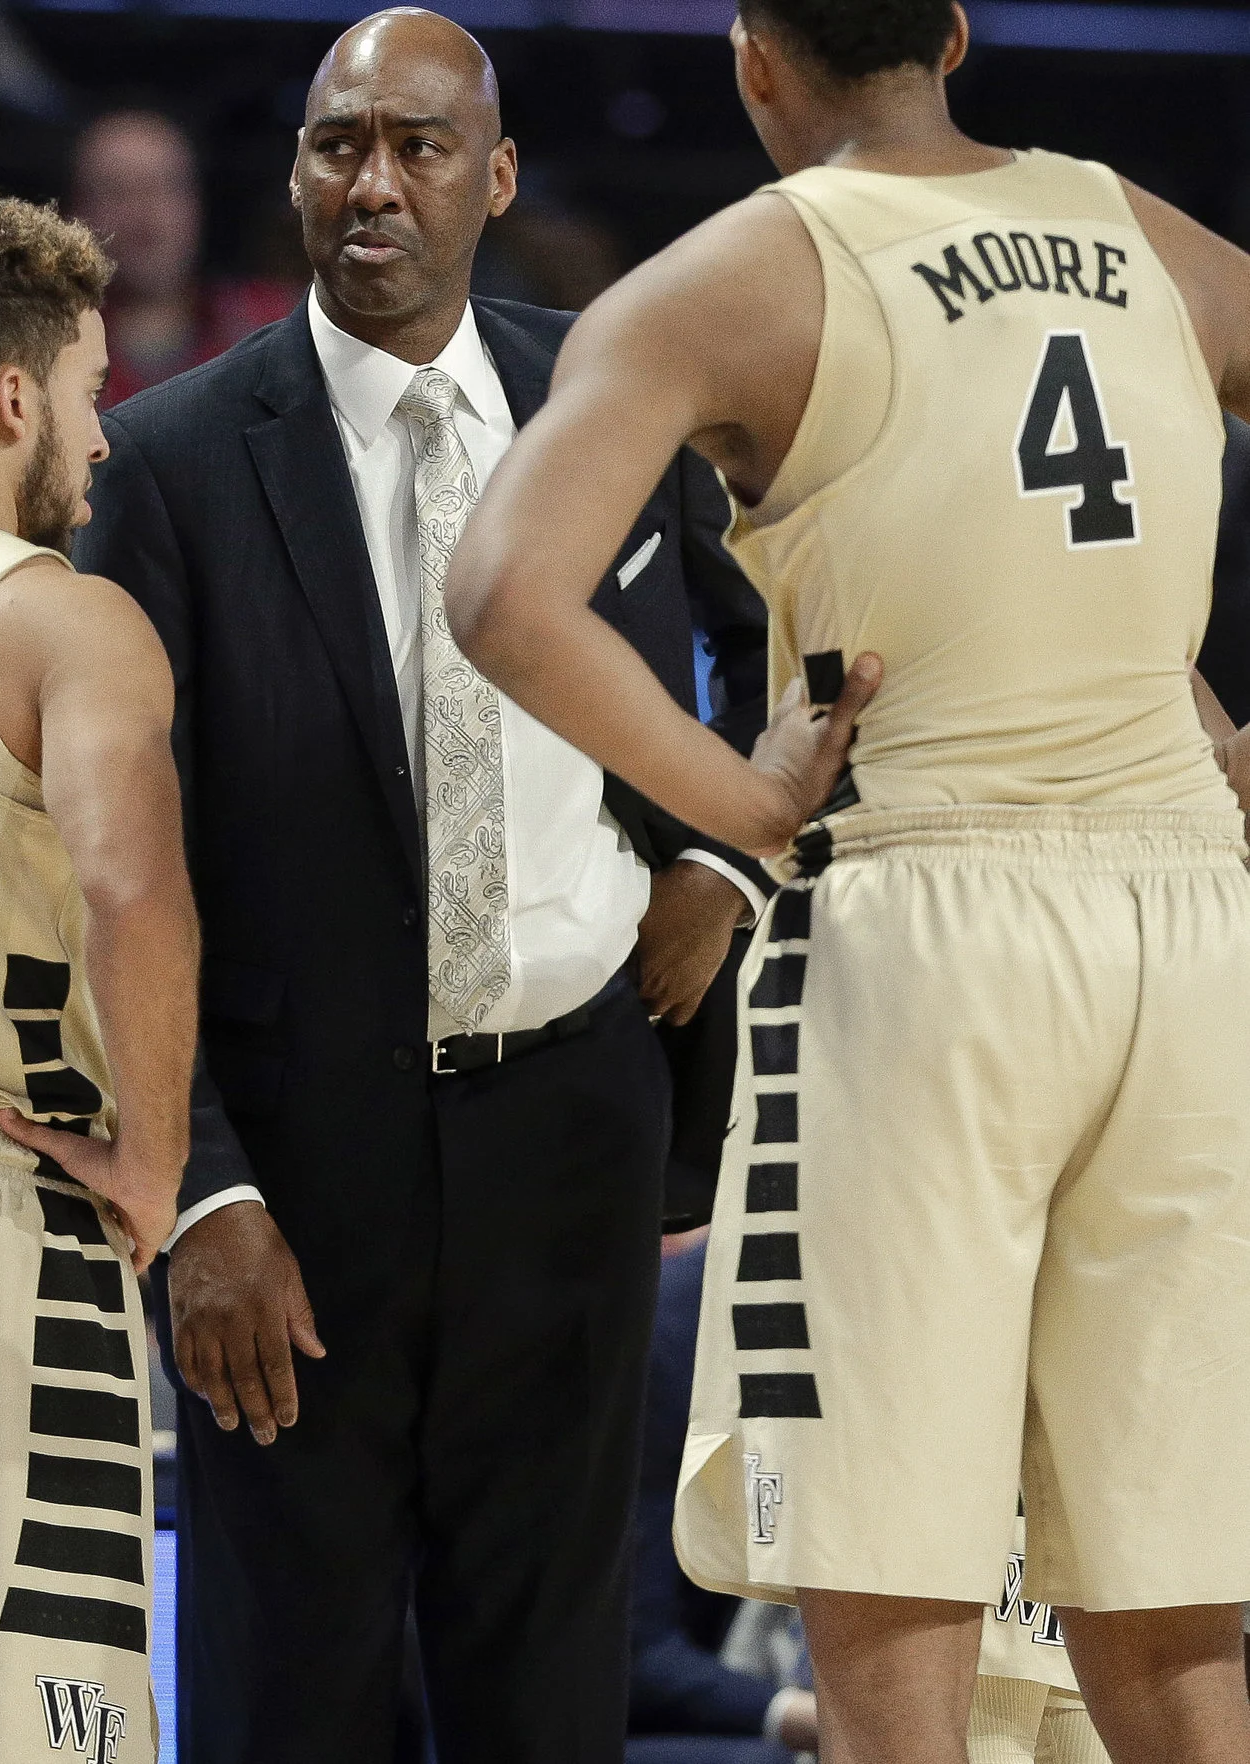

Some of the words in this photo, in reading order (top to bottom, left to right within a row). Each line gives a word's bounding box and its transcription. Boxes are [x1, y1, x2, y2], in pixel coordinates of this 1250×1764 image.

[911, 231, 1128, 324] MOORE
[1013, 328, 1141, 549] 4
[35, 1674, 128, 1764] WF
